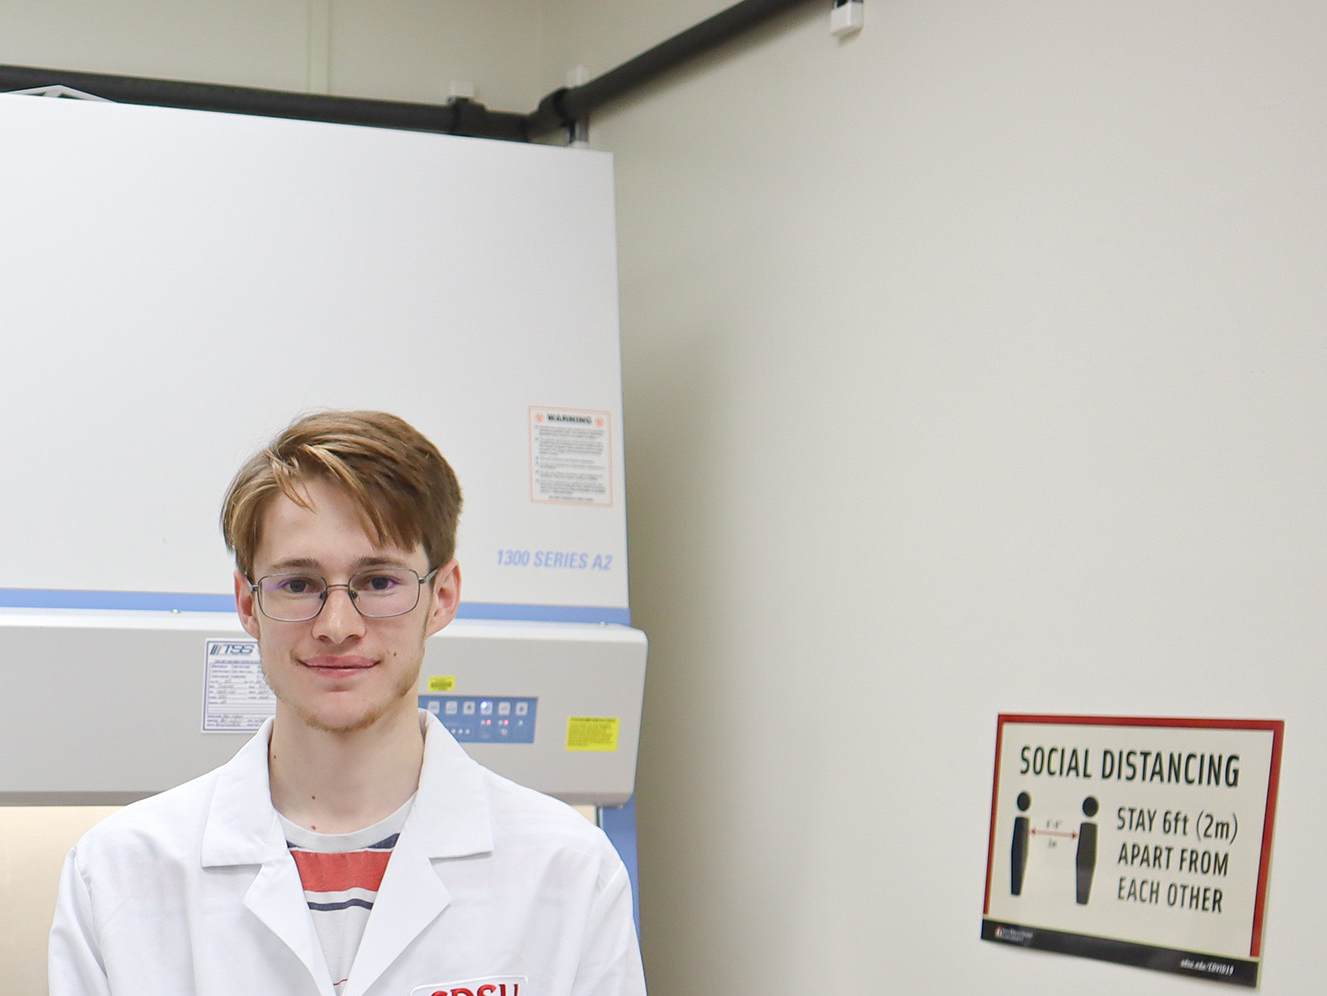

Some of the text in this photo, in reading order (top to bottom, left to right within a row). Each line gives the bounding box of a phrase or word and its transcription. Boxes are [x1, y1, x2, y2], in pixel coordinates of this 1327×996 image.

[547, 413, 593, 424] WARNING
[497, 549, 613, 571] 1300 SERIES A2
[222, 644, 255, 655] TSS
[1020, 745, 1240, 787] SOCIAL DISTANCING
[1117, 806, 1238, 845] STAY 6ft (2m)
[1118, 843, 1229, 876] APART FROM
[1118, 877, 1224, 913] EACH OTHER
